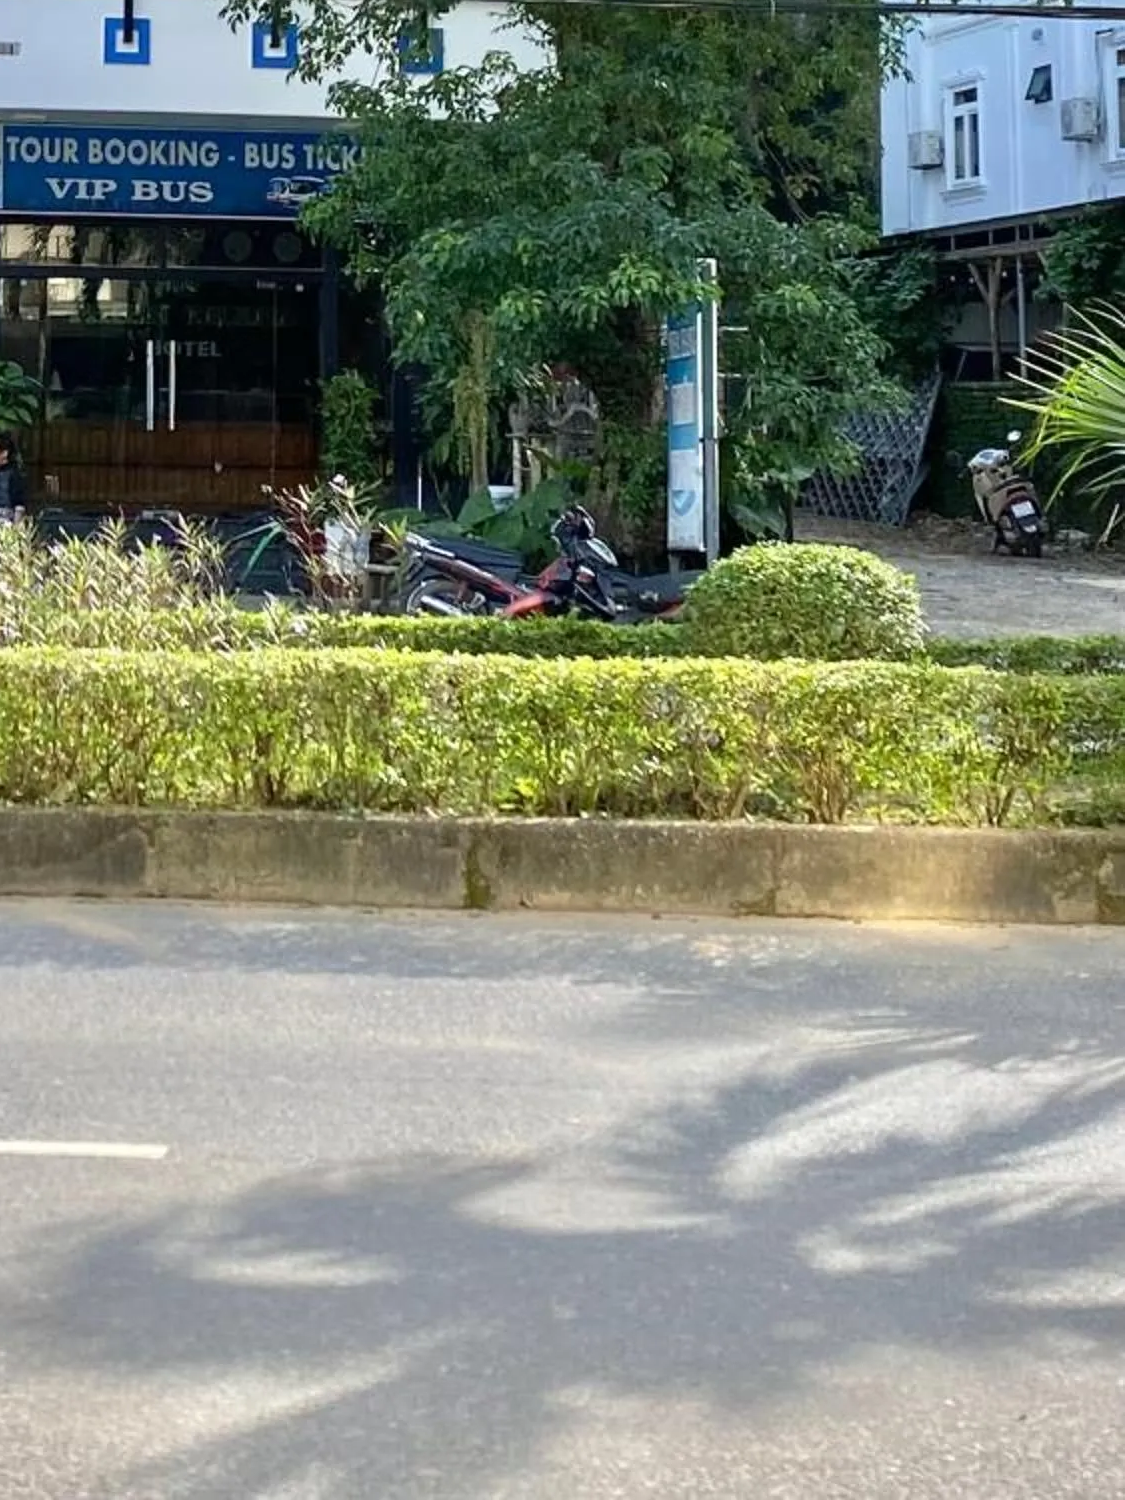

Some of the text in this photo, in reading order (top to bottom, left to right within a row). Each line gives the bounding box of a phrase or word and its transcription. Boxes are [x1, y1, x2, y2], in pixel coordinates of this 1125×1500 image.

[6, 135, 80, 164] TOUR
[87, 137, 220, 168] BOOKING
[243, 142, 296, 170] BUS
[302, 143, 367, 172] TICK
[44, 177, 214, 203] VIP BUS
